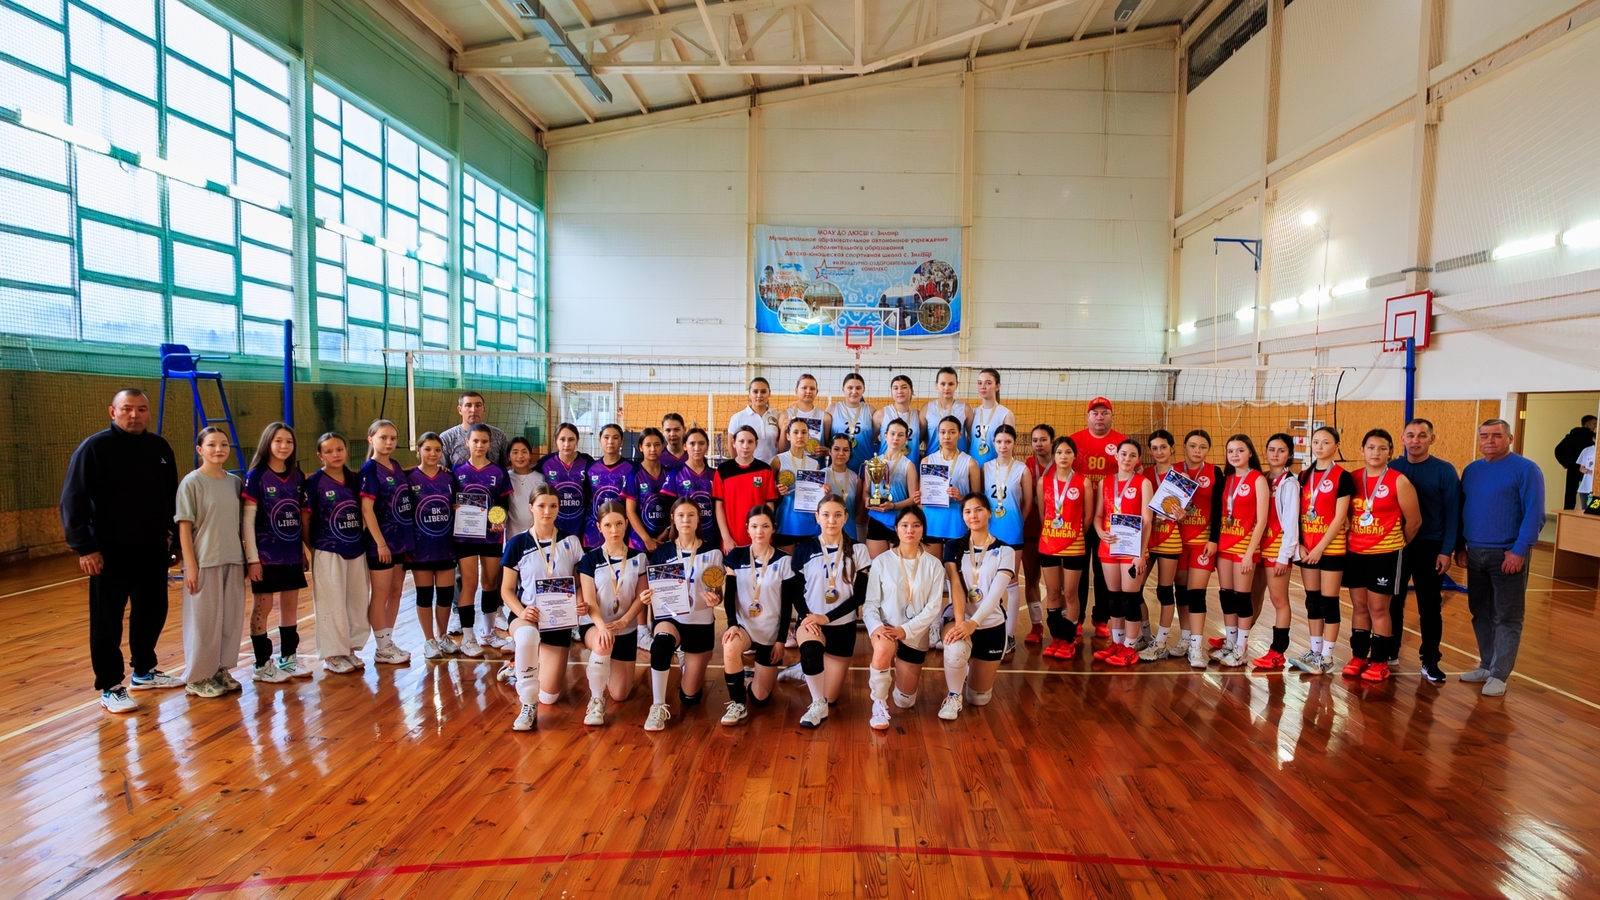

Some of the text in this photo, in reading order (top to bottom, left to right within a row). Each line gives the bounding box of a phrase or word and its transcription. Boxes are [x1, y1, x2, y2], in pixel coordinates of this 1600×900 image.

[1088, 456, 1106, 470] 80
[490, 475, 497, 486] 3
[397, 503, 412, 513] LIBE
[559, 499, 580, 507] IBERO
[423, 514, 449, 523] LIBERO
